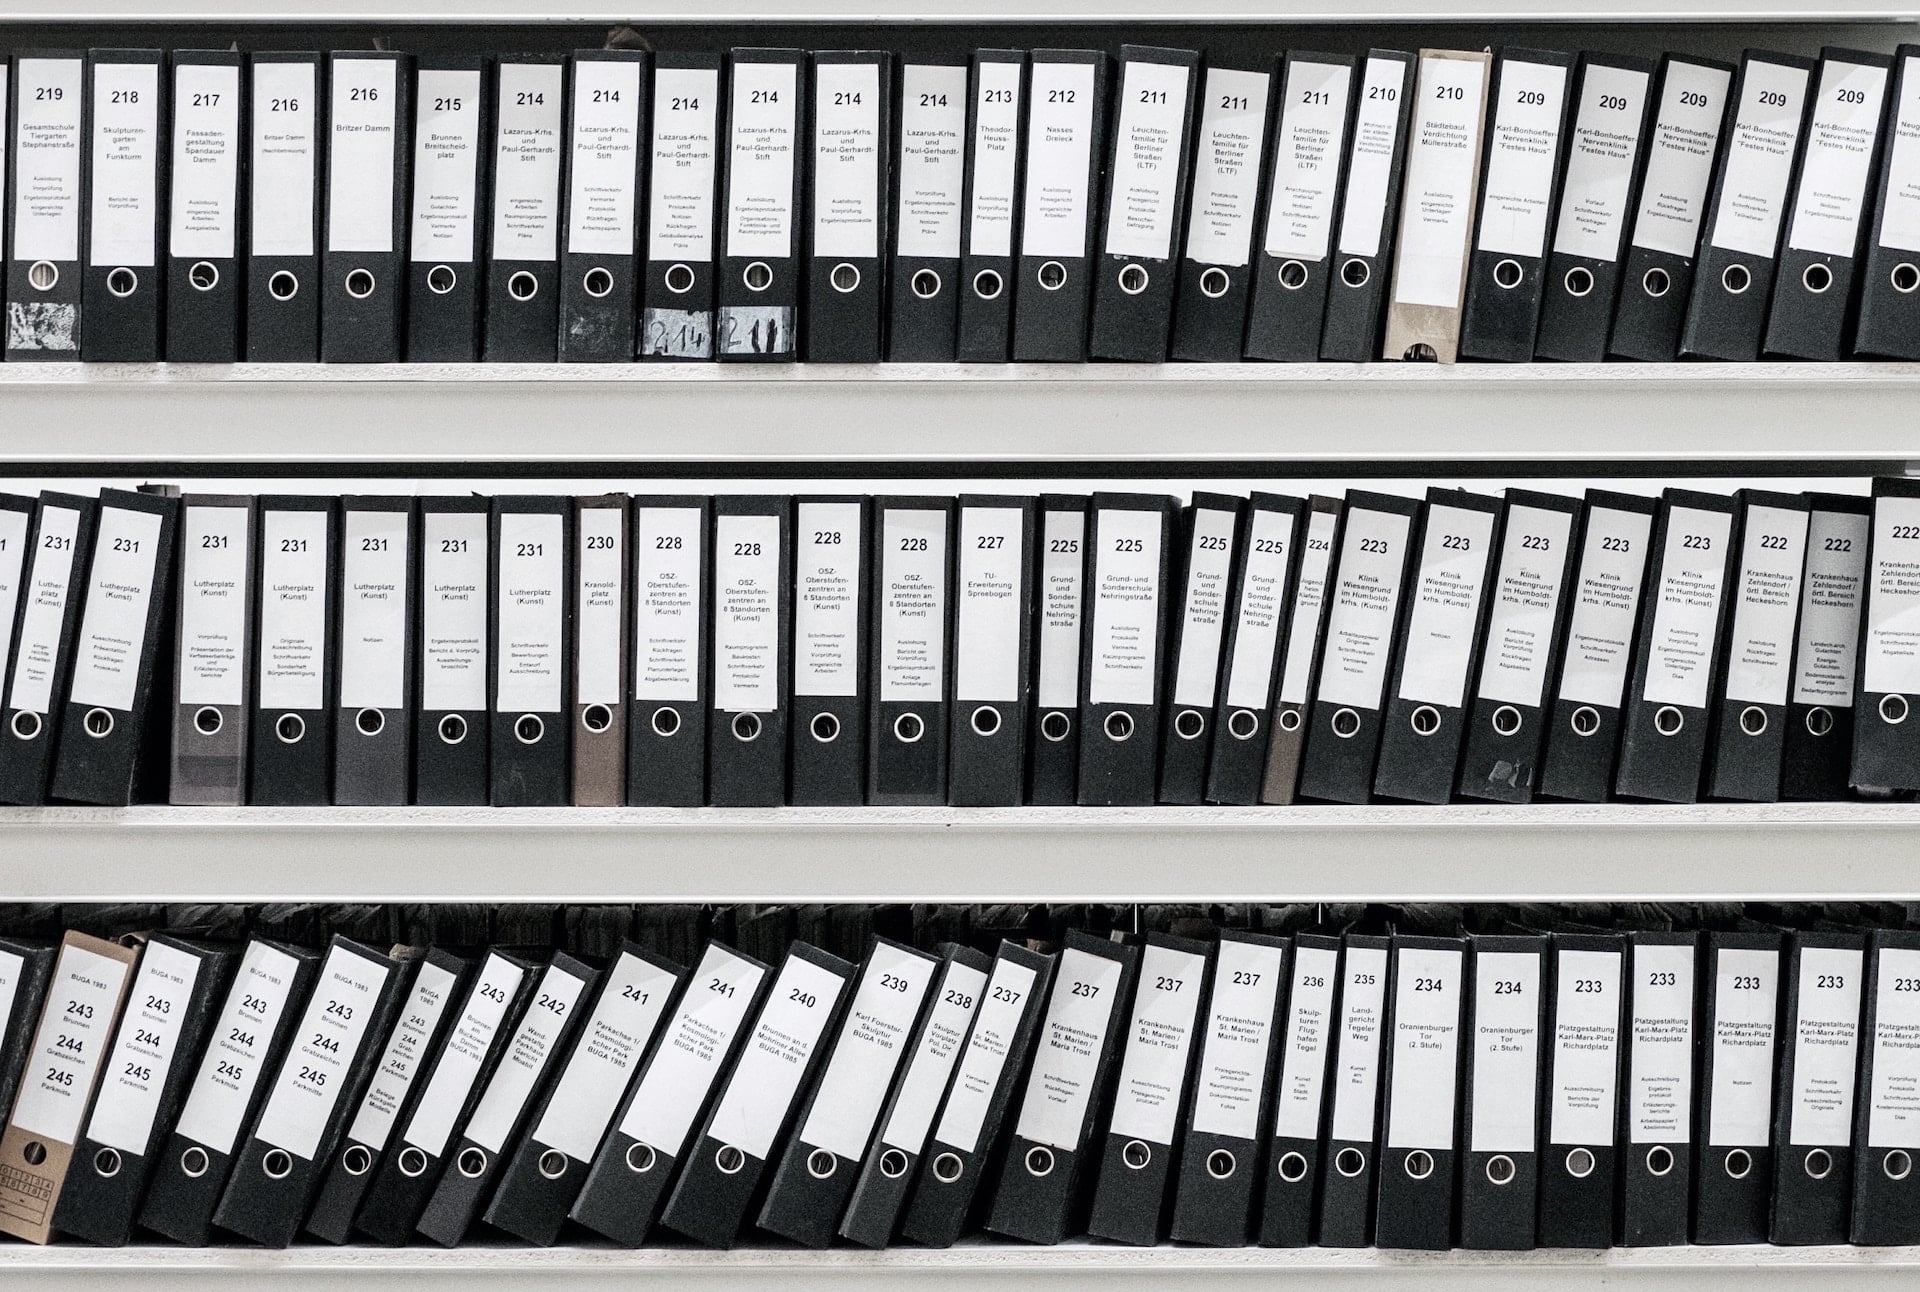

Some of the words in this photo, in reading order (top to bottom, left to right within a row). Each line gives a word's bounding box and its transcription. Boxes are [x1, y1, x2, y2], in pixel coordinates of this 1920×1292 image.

[36, 87, 63, 101] 219
[111, 91, 139, 104] 218
[193, 93, 220, 107] 217
[350, 88, 378, 101] 216
[517, 91, 544, 106] 214
[593, 90, 620, 103] 214
[751, 90, 778, 104] 214
[834, 92, 862, 105] 214
[920, 93, 948, 107] 214
[985, 90, 1012, 103] 213
[1048, 90, 1075, 103] 212
[1139, 90, 1167, 104] 211
[1302, 90, 1328, 105] 211
[1369, 86, 1396, 101] 210
[1436, 86, 1464, 100] 210
[1517, 90, 1545, 106] 209
[1680, 91, 1707, 107] 209
[1758, 91, 1786, 107] 209
[1837, 89, 1865, 104] 209
[271, 98, 298, 112] 216
[434, 98, 461, 111] 215
[672, 97, 699, 111] 214
[1221, 96, 1247, 111] 211
[1599, 95, 1627, 111] 209
[30, 133, 67, 141] Tiergarten
[1423, 130, 1467, 141] Verdichtung
[1502, 134, 1548, 145] Nervenklinik
[186, 139, 224, 147] gestaltung
[1134, 144, 1163, 152] Berliner
[1422, 139, 1467, 148] Müllerstraße
[1134, 152, 1162, 160] Straßen
[1137, 161, 1156, 170] (LTF)
[651, 320, 704, 352] 214
[814, 531, 841, 544] 228
[1892, 526, 1920, 539] 222
[44, 535, 70, 551] 231
[113, 537, 139, 553] 231
[202, 535, 227, 549] 231
[281, 539, 306, 552] 231
[362, 538, 387, 552] 231
[442, 539, 467, 553] 231
[587, 536, 614, 549] 230
[656, 536, 682, 550] 228
[900, 538, 928, 552] 228
[977, 536, 1004, 549] 227
[1050, 539, 1078, 553] 225
[1115, 539, 1143, 552] 225
[1199, 536, 1227, 551] 225
[1255, 539, 1283, 555] 225
[1308, 539, 1329, 551] 224
[1360, 538, 1388, 554] 223
[1442, 535, 1470, 551] 223
[1522, 535, 1550, 551] 223
[1601, 537, 1629, 552] 223
[1683, 535, 1710, 550] 223
[1761, 535, 1788, 550] 222
[1824, 538, 1851, 552] 222
[517, 544, 542, 557] 231
[734, 543, 761, 556] 228
[1747, 569, 1793, 580] Krankenhaus
[194, 580, 235, 588] Lutherplatz
[968, 581, 1012, 590] Erweiterung
[1102, 583, 1152, 592] Sonderschule
[1748, 579, 1786, 588] Zehlendorf
[968, 590, 1012, 598] Spreebogen
[1101, 593, 1152, 601] Nehringstraße
[1763, 588, 1790, 598] Bereich
[1746, 596, 1788, 606] Heckeshorn
[334, 973, 352, 985] BUGA
[880, 974, 908, 992] 239
[1155, 976, 1183, 992] 237
[1232, 971, 1261, 986] 237
[1302, 976, 1325, 987] 236
[1354, 974, 1375, 985] 235
[1415, 978, 1443, 992] 234
[1650, 972, 1675, 986] 233
[1733, 976, 1760, 990] 233
[1817, 975, 1844, 989] 233
[1895, 979, 1920, 991] 233
[480, 983, 505, 1003] 243
[709, 978, 735, 999] 241
[1071, 981, 1100, 999] 237
[1495, 981, 1522, 995] 234
[1575, 980, 1602, 993] 233
[622, 985, 649, 1005] 241
[789, 988, 816, 1008] 240
[945, 990, 972, 1009] 238
[992, 986, 1022, 1005] 237
[66, 1000, 94, 1019] 243
[326, 1000, 353, 1020] 243
[538, 994, 565, 1016] 242
[321, 1015, 348, 1030] Brunnen
[1138, 1018, 1184, 1034] Krankenhaus
[853, 1029, 874, 1042] BUGA
[861, 1022, 892, 1038] Skulptur
[1480, 1026, 1534, 1035] Oranienburger
[56, 1034, 83, 1053] 244
[312, 1033, 339, 1054] 244
[1138, 1036, 1156, 1045] Maria
[1159, 1040, 1179, 1050] Trost
[1297, 1034, 1317, 1042] hafen
[1296, 1043, 1316, 1052] Tegel
[46, 1068, 74, 1086] 245
[299, 1066, 327, 1086] 245
